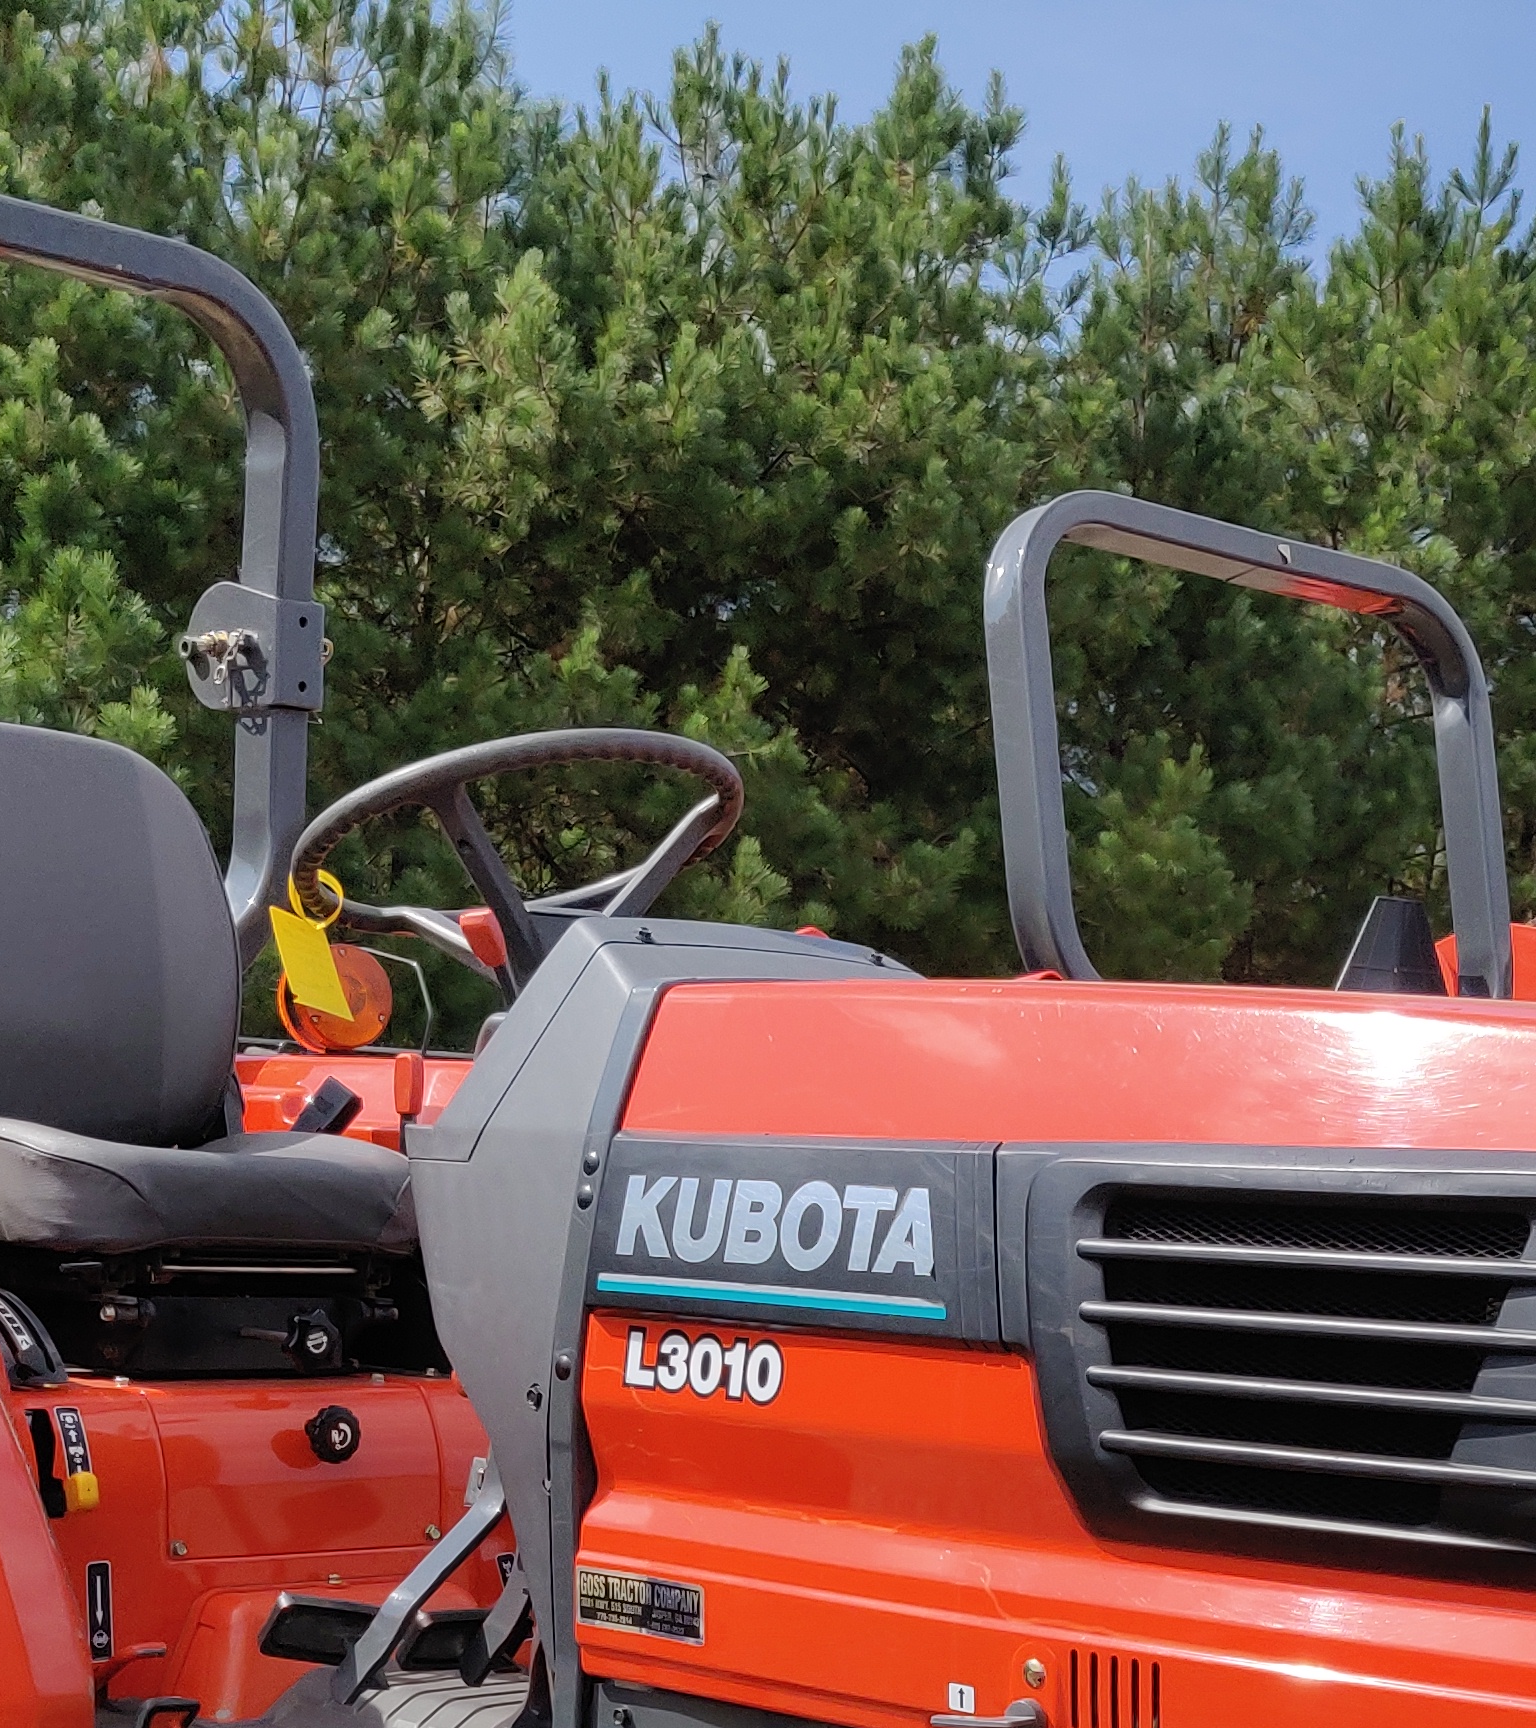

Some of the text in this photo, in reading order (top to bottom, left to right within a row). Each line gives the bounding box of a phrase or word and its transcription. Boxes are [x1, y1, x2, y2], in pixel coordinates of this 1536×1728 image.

[615, 1174, 935, 1277] KUBOTA
[623, 1328, 784, 1403] L3010
[580, 1572, 606, 1599] GOSS
[607, 1576, 652, 1606] TRACTOR
[653, 1585, 700, 1614] COMPANY
